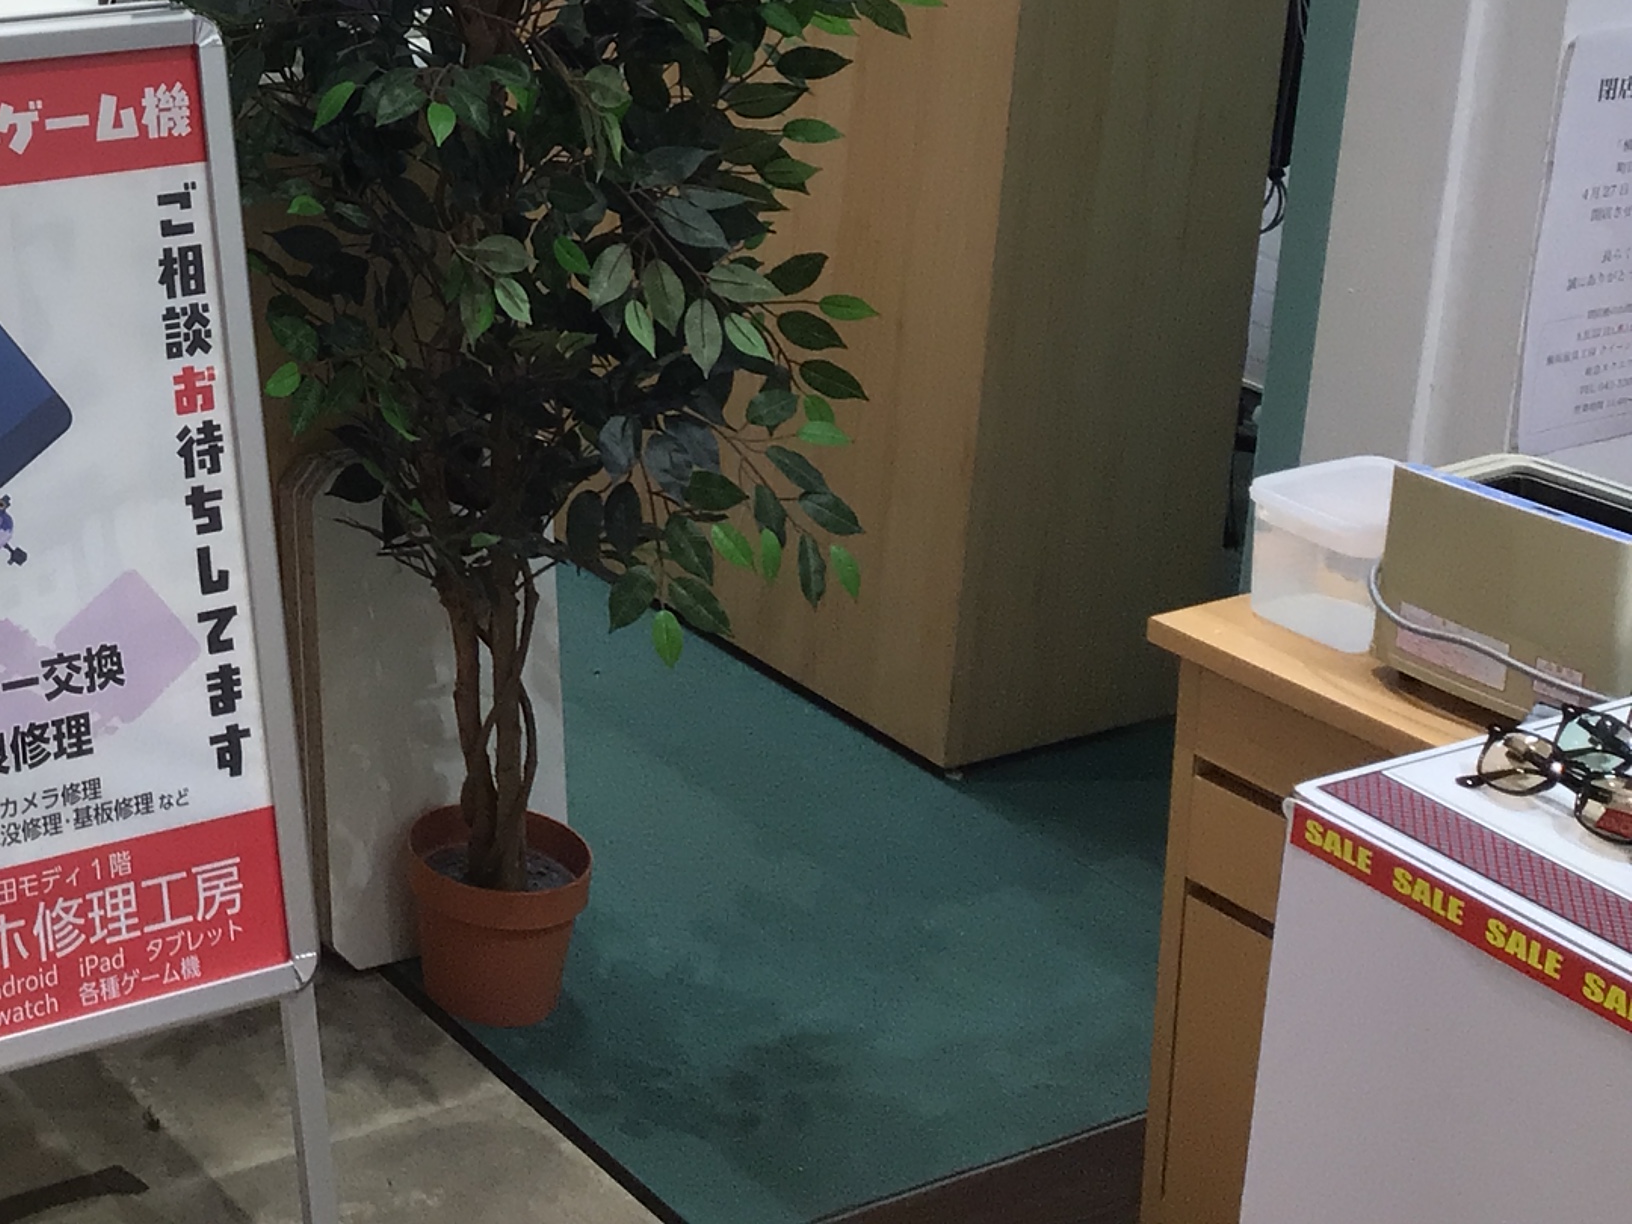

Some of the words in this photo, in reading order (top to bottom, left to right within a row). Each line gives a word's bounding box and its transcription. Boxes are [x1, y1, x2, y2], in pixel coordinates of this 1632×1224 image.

[157, 181, 252, 777] ご相談お待ちしてます
[1304, 818, 1373, 875] SALE
[1392, 866, 1465, 926] SALE
[79, 947, 125, 979] iPad
[147, 919, 244, 963] タブレット
[1485, 917, 1563, 980] SALE
[79, 955, 202, 1007] 各種ゲーム機
[1582, 971, 1632, 1022] SA
